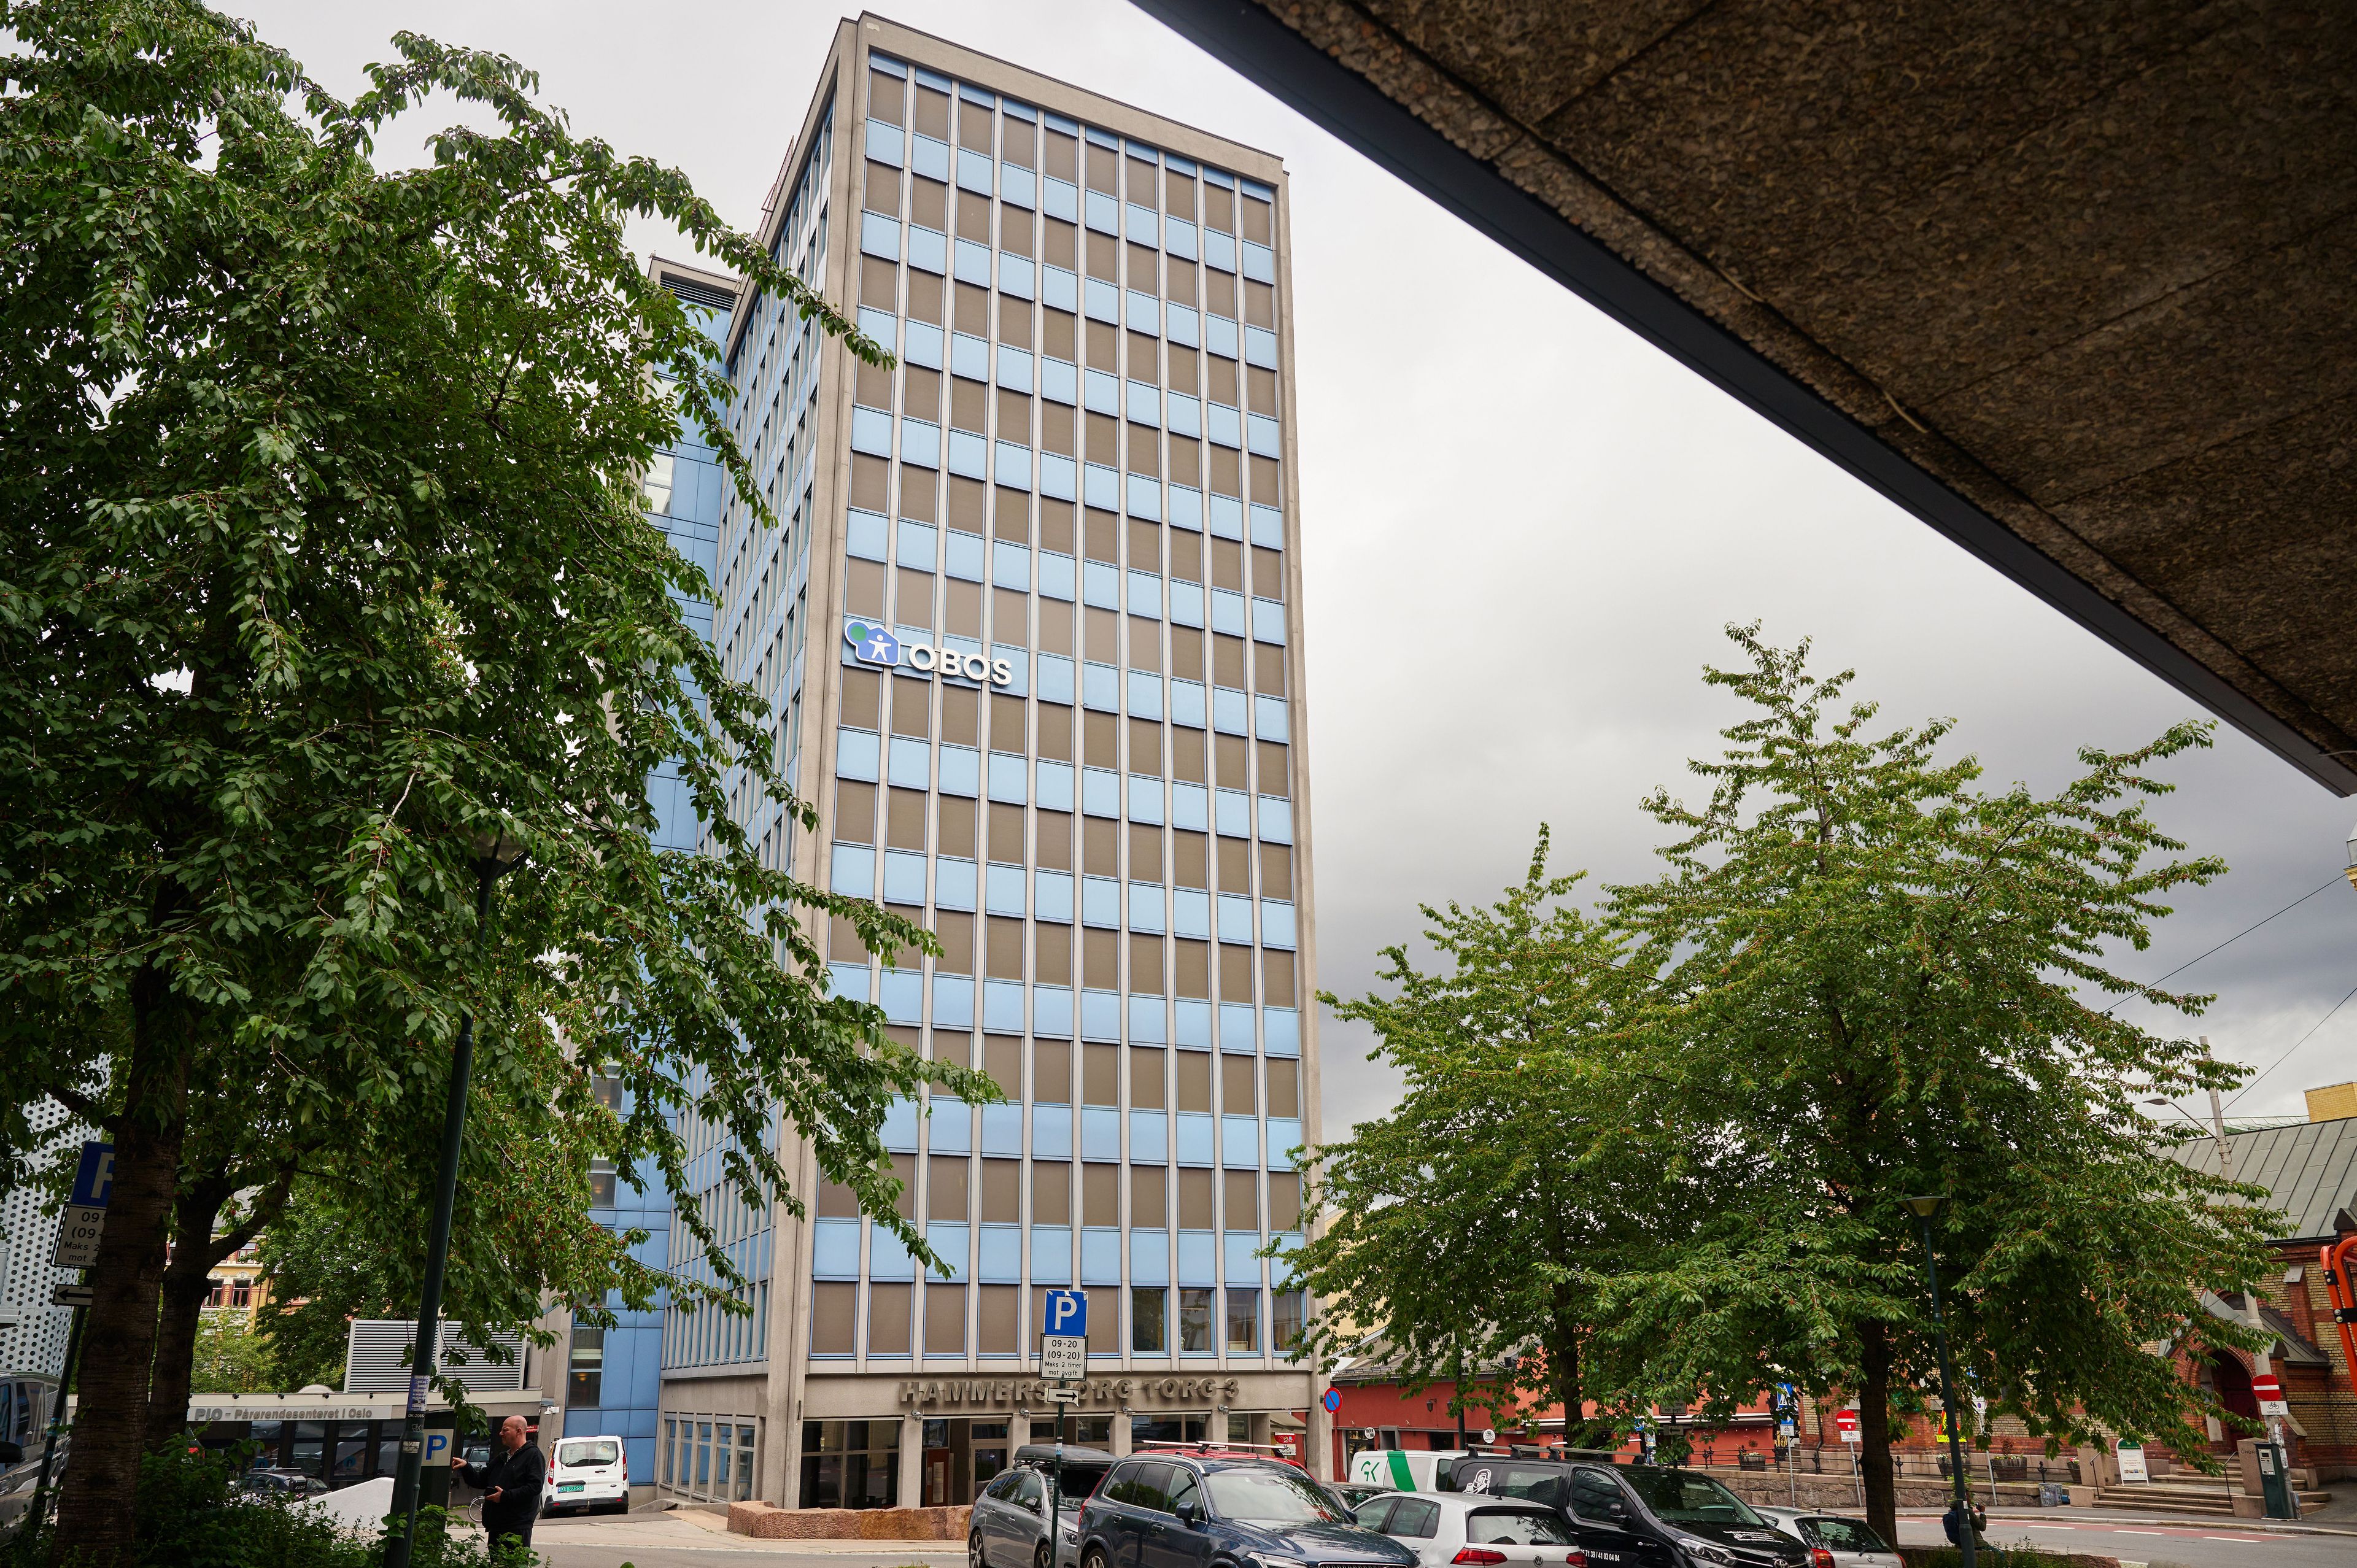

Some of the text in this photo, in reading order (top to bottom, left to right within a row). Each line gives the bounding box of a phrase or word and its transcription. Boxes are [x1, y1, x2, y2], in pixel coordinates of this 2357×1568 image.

[908, 643, 1013, 686] OBOS
[64, 1241, 89, 1251] Maks
[1055, 1296, 1077, 1330] P
[1051, 1339, 1077, 1348] 09-20
[1048, 1350, 1080, 1361] (09-20)
[1141, 1378, 1217, 1399] TORG
[1223, 1378, 1239, 1398] 3
[195, 1408, 223, 1420] PIO
[234, 1408, 339, 1419] Pårørendesenteret
[348, 1408, 372, 1418] Oslo
[425, 1435, 447, 1461] P
[1360, 1461, 1380, 1482] GK
